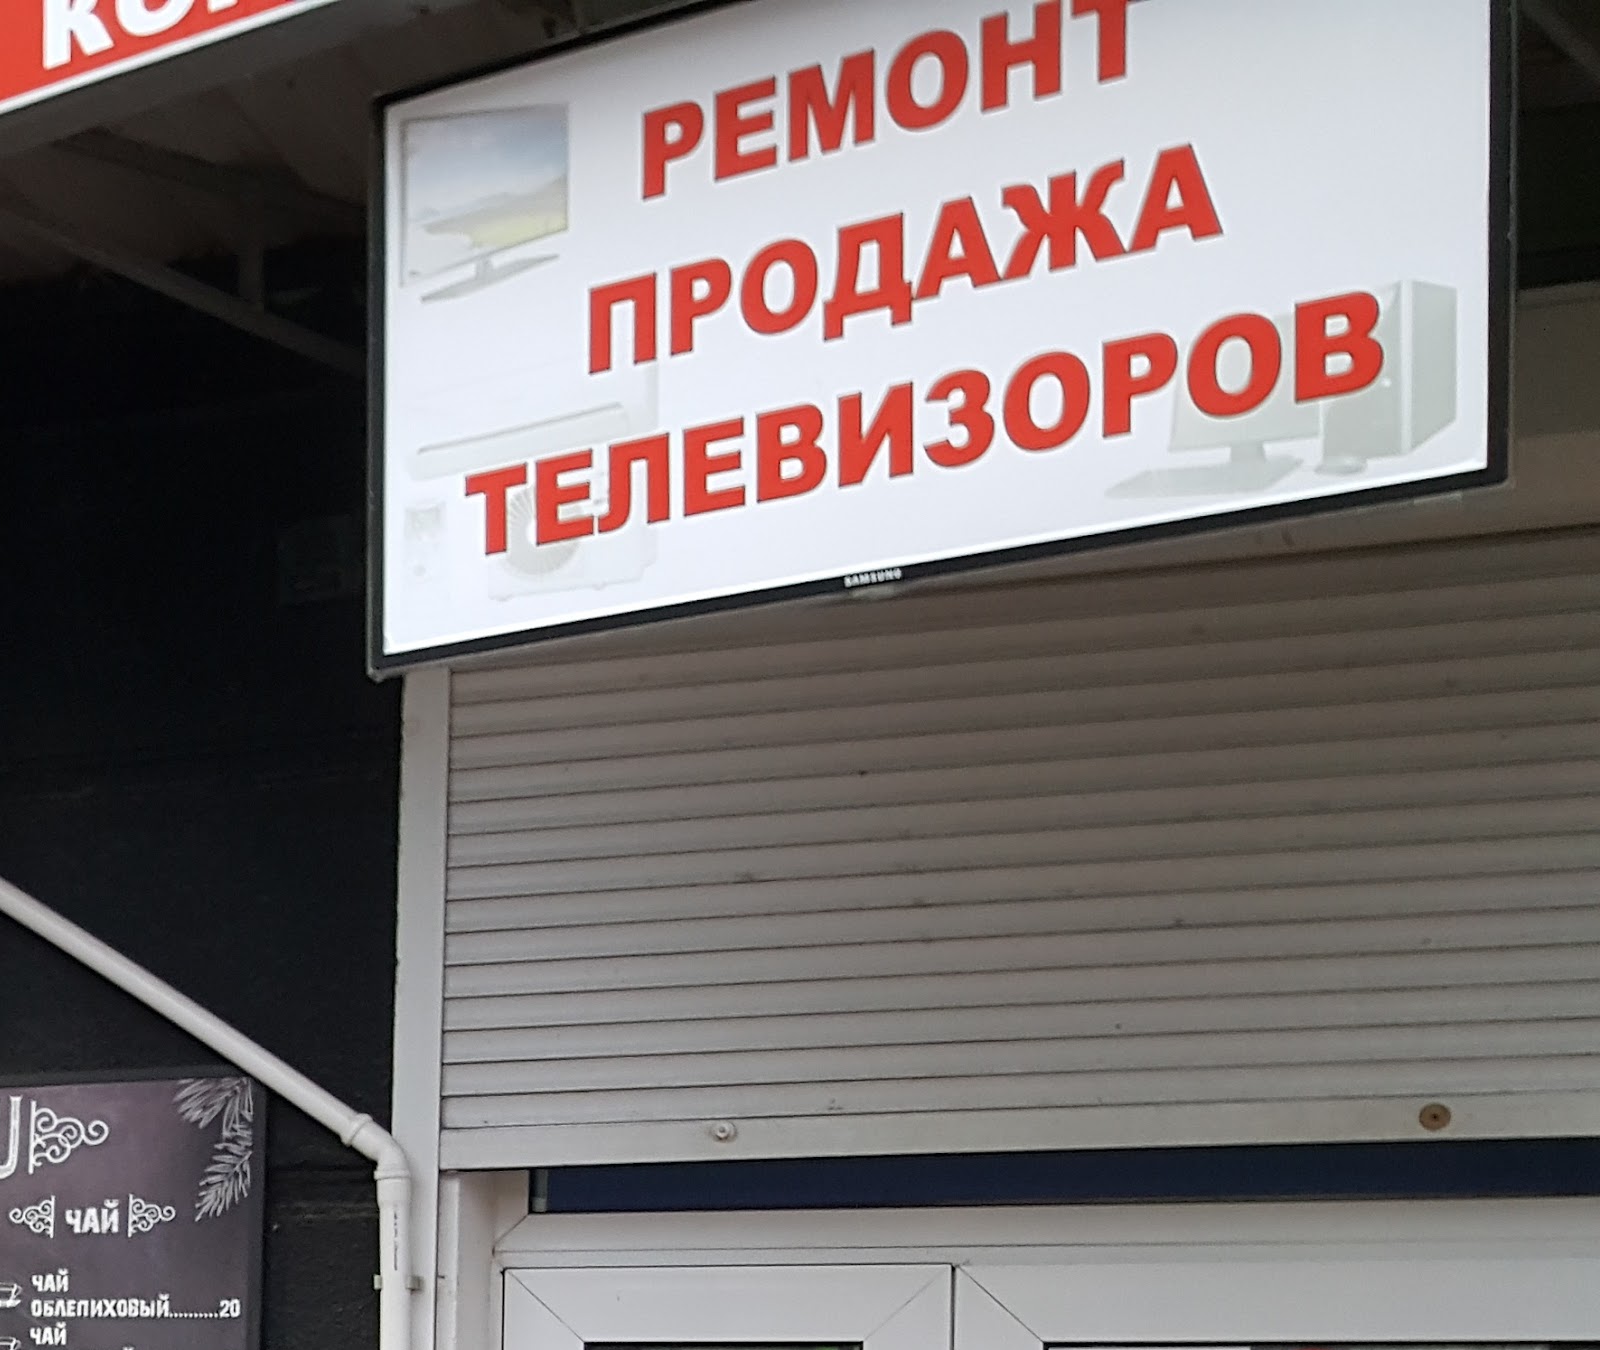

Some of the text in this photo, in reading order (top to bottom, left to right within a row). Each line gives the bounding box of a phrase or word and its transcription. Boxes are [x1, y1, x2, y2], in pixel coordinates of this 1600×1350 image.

[640, 0, 1142, 200] РЕМОНТ
[587, 143, 1224, 375] ПРОДАЖА
[464, 290, 1384, 556] ТЕЛЕВИЗОРОВ
[843, 567, 902, 588] SAMSUNG
[65, 1199, 119, 1234] ЧАЙ
[30, 1268, 69, 1292] ЧАЙ
[29, 1321, 67, 1345] ЧАЙ
